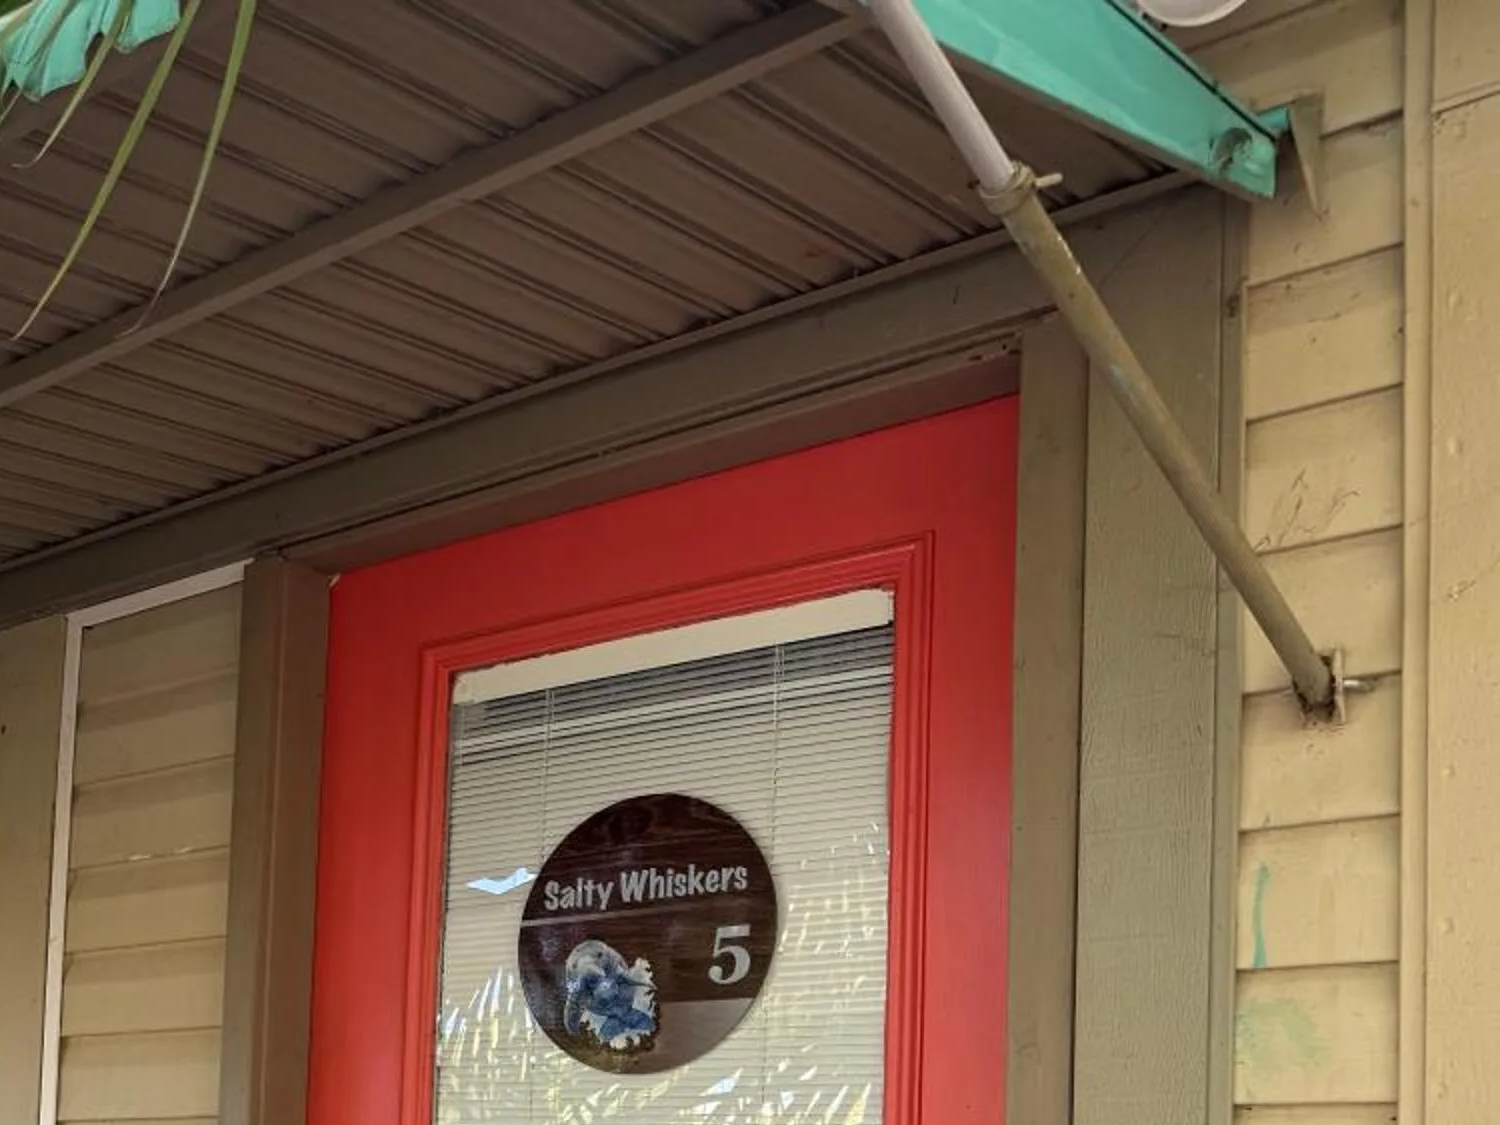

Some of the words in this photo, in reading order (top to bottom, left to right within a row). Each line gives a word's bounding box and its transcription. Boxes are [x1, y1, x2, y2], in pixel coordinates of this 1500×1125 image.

[544, 877, 614, 910] Salty
[621, 864, 747, 902] Whiskers
[708, 924, 751, 985] 5
